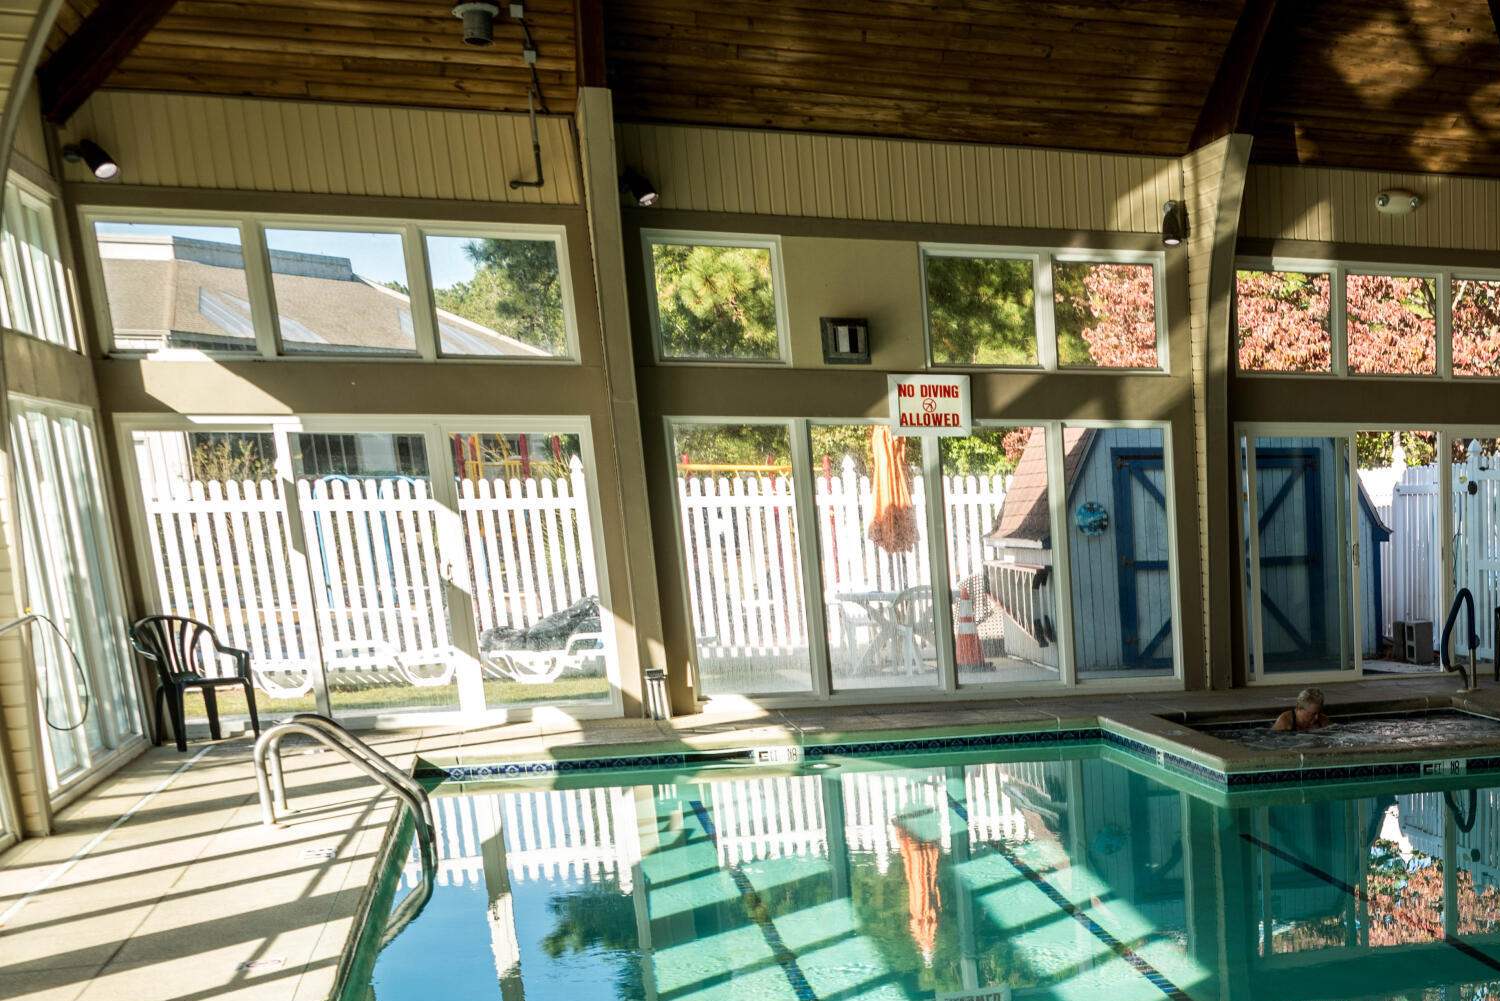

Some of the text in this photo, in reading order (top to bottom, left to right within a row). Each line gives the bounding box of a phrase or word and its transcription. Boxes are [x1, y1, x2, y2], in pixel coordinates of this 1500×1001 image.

[898, 383, 959, 398] NO DIVING
[899, 412, 960, 427] ALLOWED
